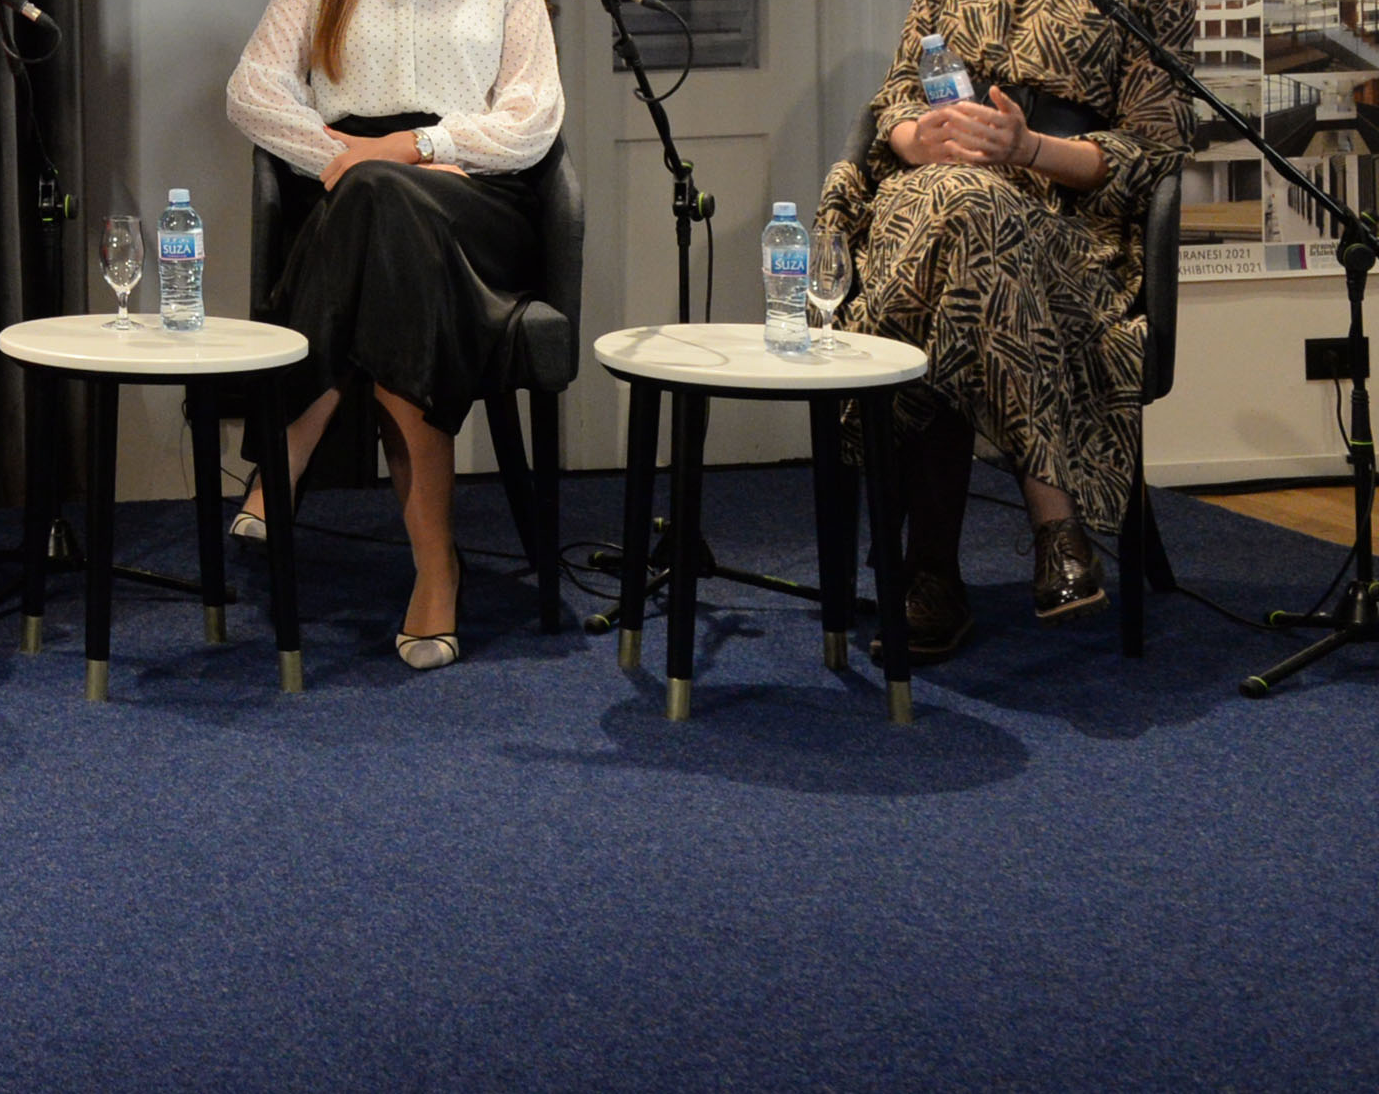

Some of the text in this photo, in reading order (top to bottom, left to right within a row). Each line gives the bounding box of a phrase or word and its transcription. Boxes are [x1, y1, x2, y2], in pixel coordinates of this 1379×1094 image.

[163, 243, 192, 255] SUZA
[1179, 248, 1251, 260] IRANESI 2021
[775, 258, 805, 271] SUZA
[1178, 262, 1262, 275] XHIBITION 2021
